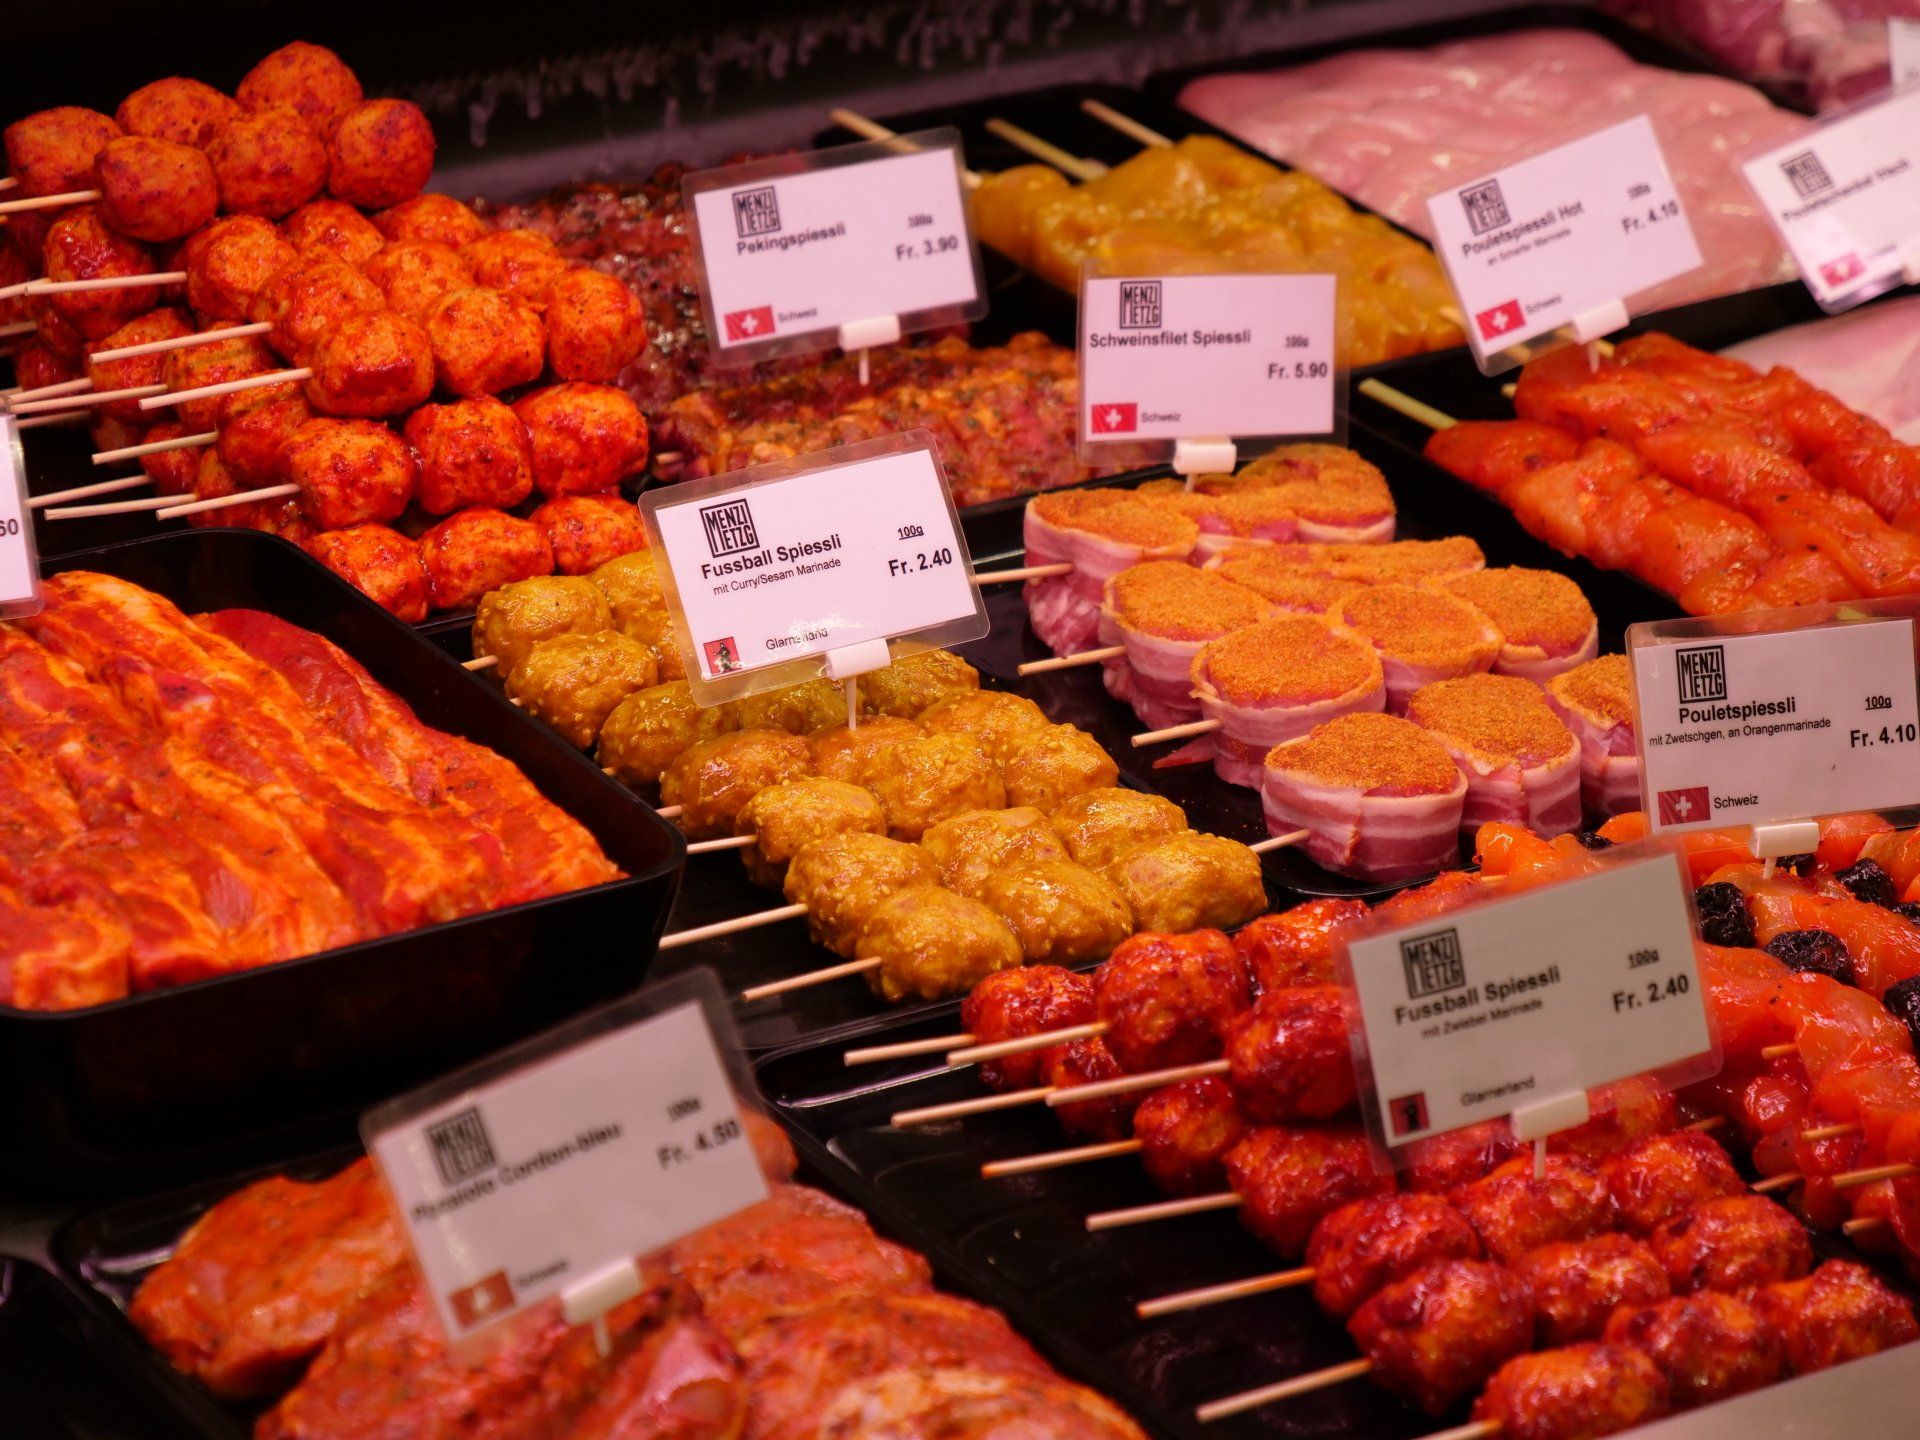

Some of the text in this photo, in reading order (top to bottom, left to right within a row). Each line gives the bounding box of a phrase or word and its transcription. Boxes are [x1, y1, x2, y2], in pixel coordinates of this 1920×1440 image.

[1462, 201, 1583, 257] Pouletspiessli Hot
[1622, 201, 1678, 234] Fr. 4.10
[737, 223, 846, 255] Pekingspiessli
[895, 235, 958, 261] Fr. 3.90
[1123, 285, 1158, 305] MENZI
[778, 307, 818, 323] Schweiz
[1090, 329, 1251, 348] Schweinsfilet Spiessli
[1268, 362, 1328, 379] Fr. 5.90
[1141, 412, 1181, 423] Schweiz
[705, 505, 748, 530] MENZI
[898, 523, 924, 540] 100g
[701, 534, 842, 579] Fussball Spiessli
[888, 548, 952, 577] Fr. 2.40
[713, 558, 841, 595] mit Curry/Sesam Marinade
[1680, 651, 1720, 675] MENZI
[1679, 697, 1796, 724] Pouletspiessli
[1865, 696, 1892, 710] 100g
[1649, 717, 1831, 747] mit Zwetschgen, an Orangenmarinade
[1851, 724, 1916, 748] Fr. 4.10
[1714, 795, 1759, 809] Schweiz
[1406, 937, 1455, 965] MENZI
[1628, 949, 1660, 969] 100g
[1395, 965, 1560, 1025] Fussball Spiessli
[1613, 974, 1688, 1012] Fr. 2.40
[1422, 1025, 1440, 1039] mit
[1460, 1075, 1536, 1107] Glarnerland
